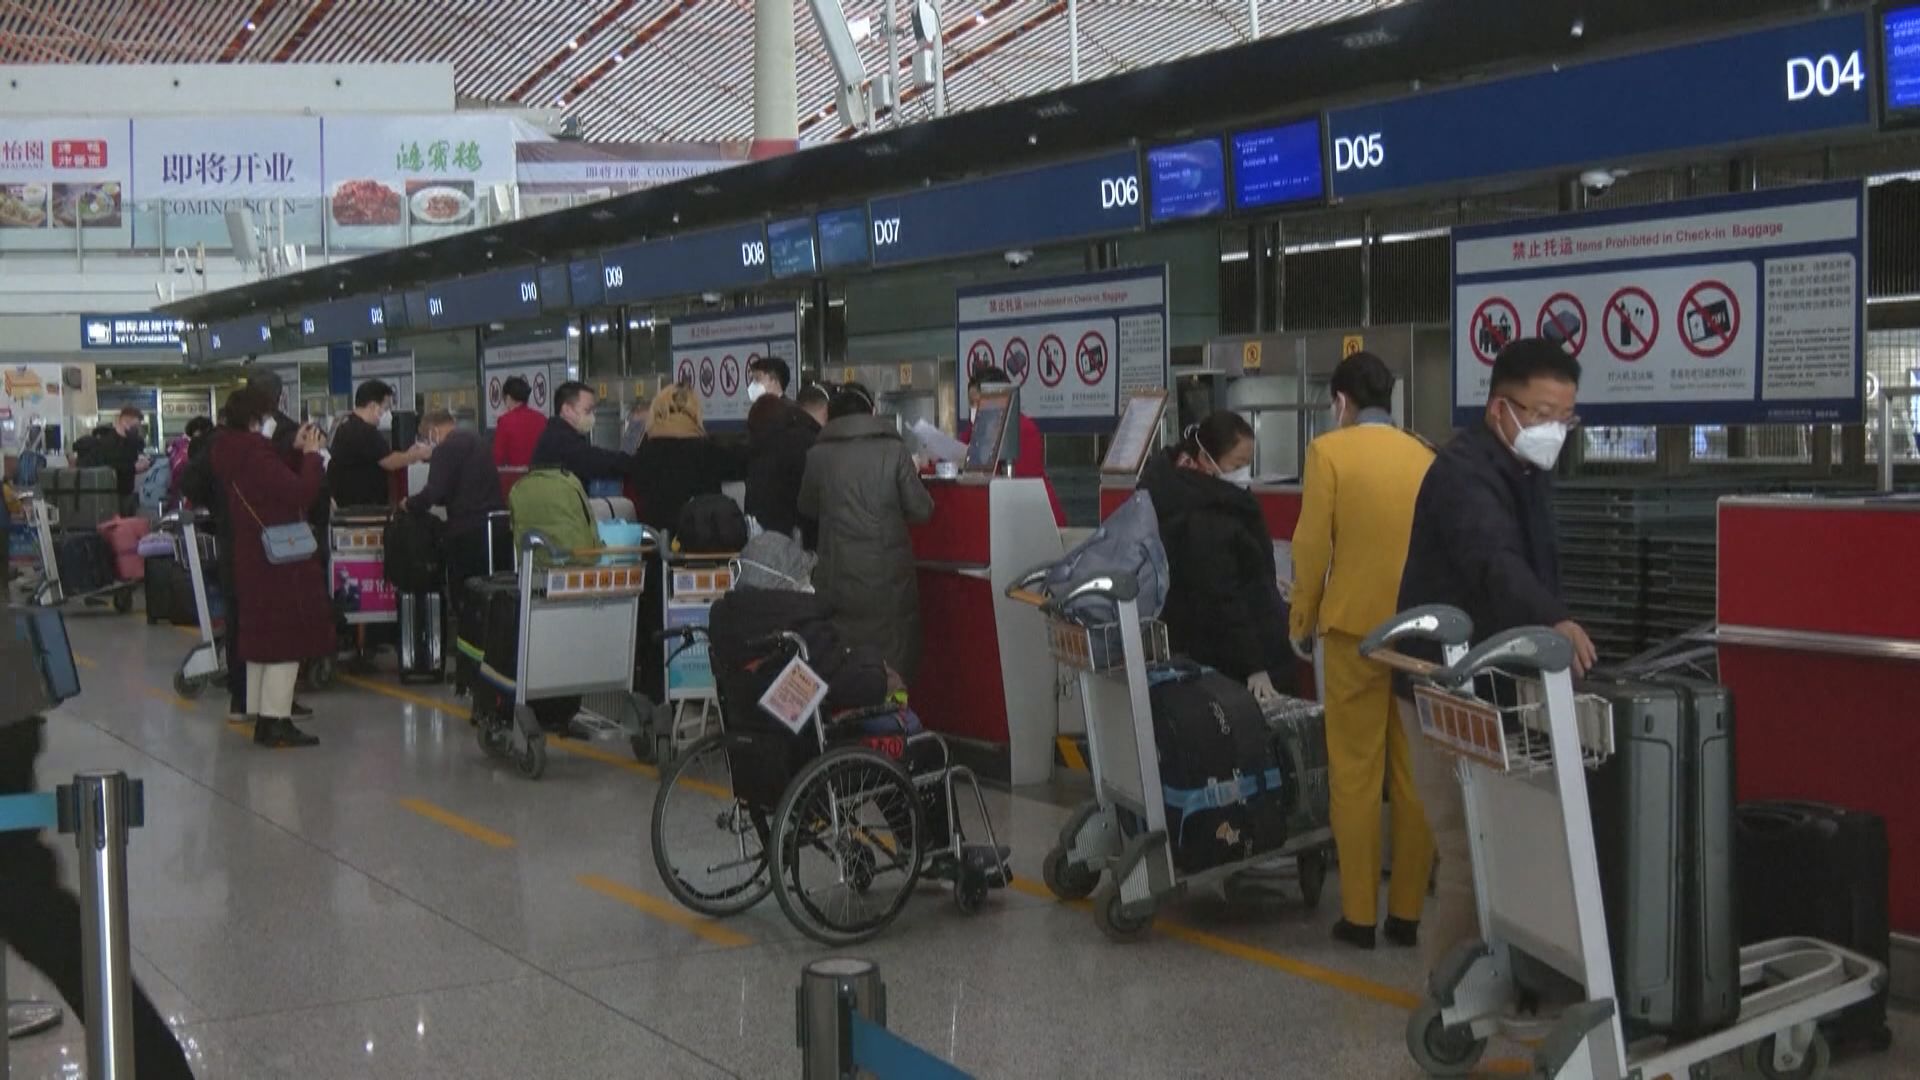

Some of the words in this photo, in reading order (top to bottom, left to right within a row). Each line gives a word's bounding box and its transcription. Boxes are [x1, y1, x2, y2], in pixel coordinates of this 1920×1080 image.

[1786, 50, 1865, 101] D04
[1334, 132, 1384, 172] D05
[162, 152, 295, 185] 即将开业
[647, 165, 698, 178] COMING
[1101, 176, 1139, 209] D06
[874, 218, 901, 247] D07
[1512, 236, 1573, 260] 禁止托运
[1576, 240, 1603, 253] Items
[1605, 233, 1660, 249] Prohibited
[1662, 232, 1673, 244] in
[1675, 227, 1726, 243] Check-in
[1732, 222, 1784, 239] Baggage
[741, 241, 765, 267] D08
[605, 266, 623, 288] D09
[521, 282, 537, 302] D10
[371, 307, 384, 324] D12
[429, 298, 443, 316] D11
